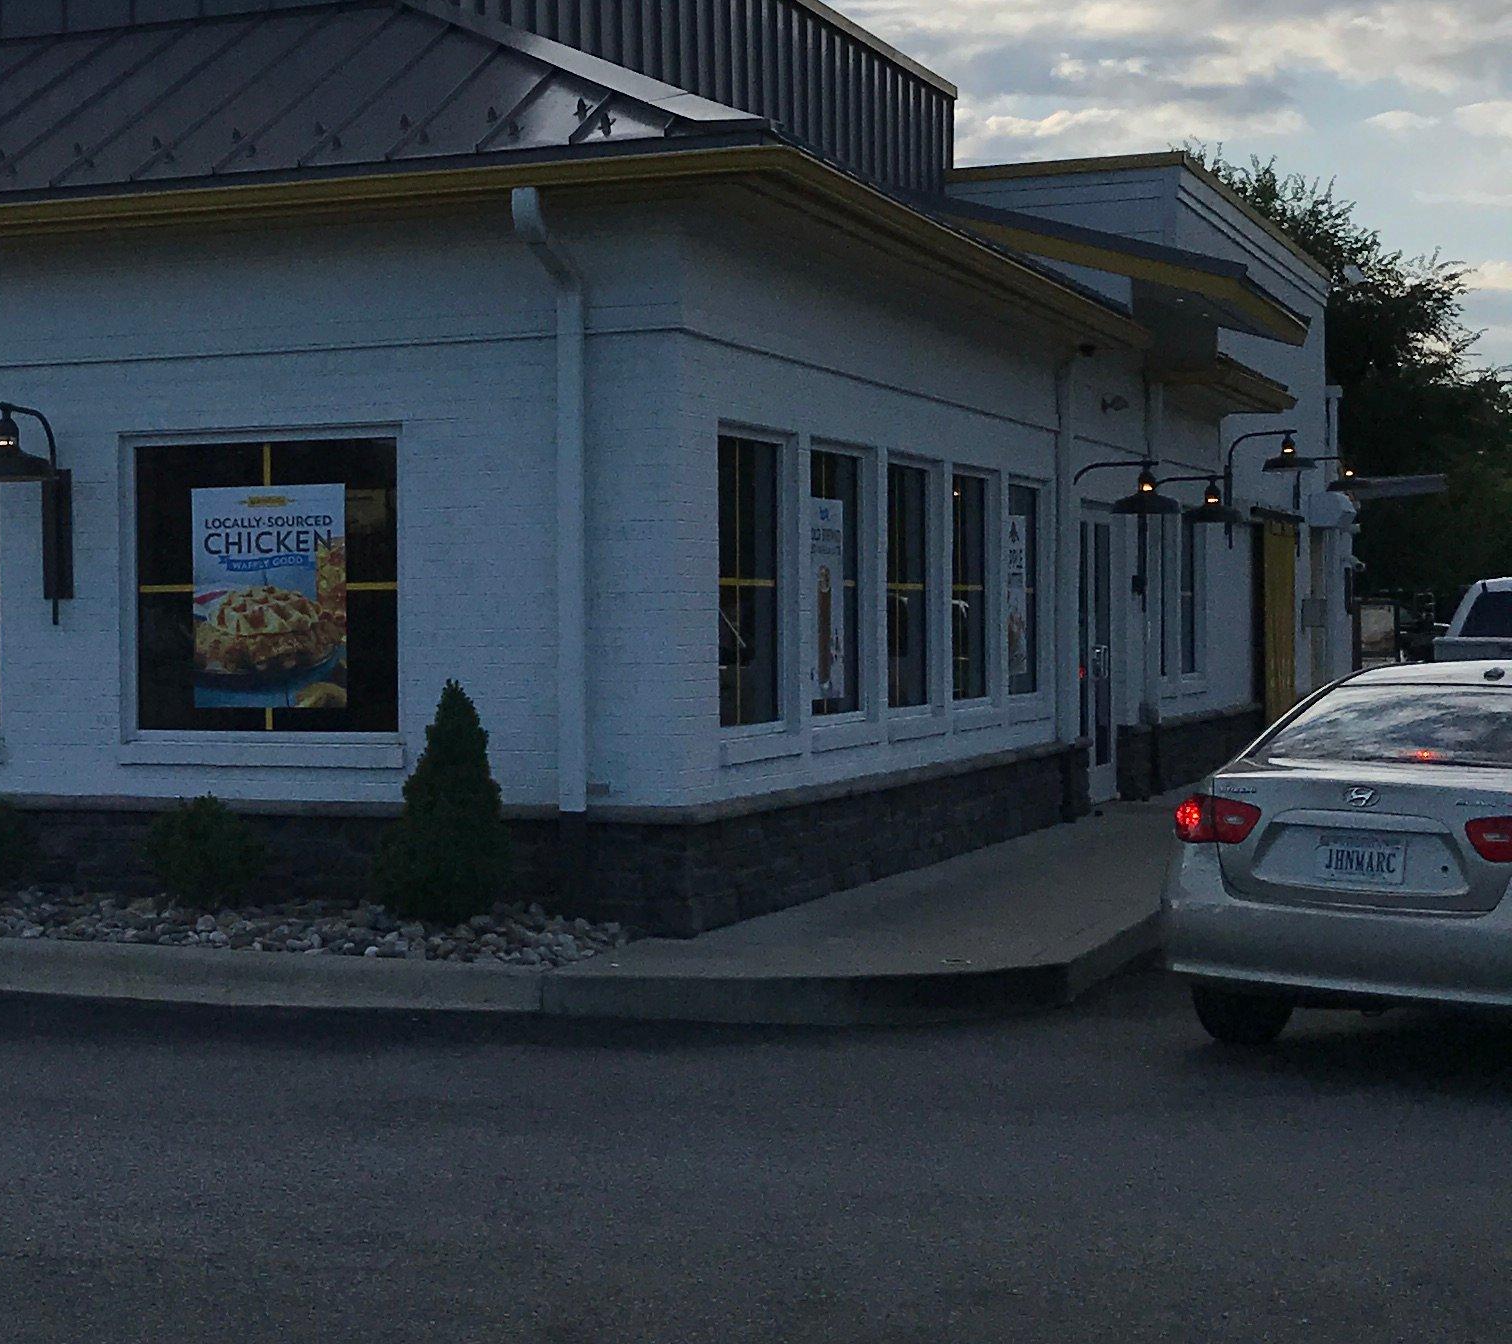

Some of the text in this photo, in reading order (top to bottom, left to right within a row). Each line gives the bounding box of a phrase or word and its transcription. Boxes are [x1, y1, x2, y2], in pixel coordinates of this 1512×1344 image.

[204, 515, 333, 530] LOCALLY-SOURCED
[203, 529, 333, 555] CHICKEN
[272, 555, 303, 567] GOOD
